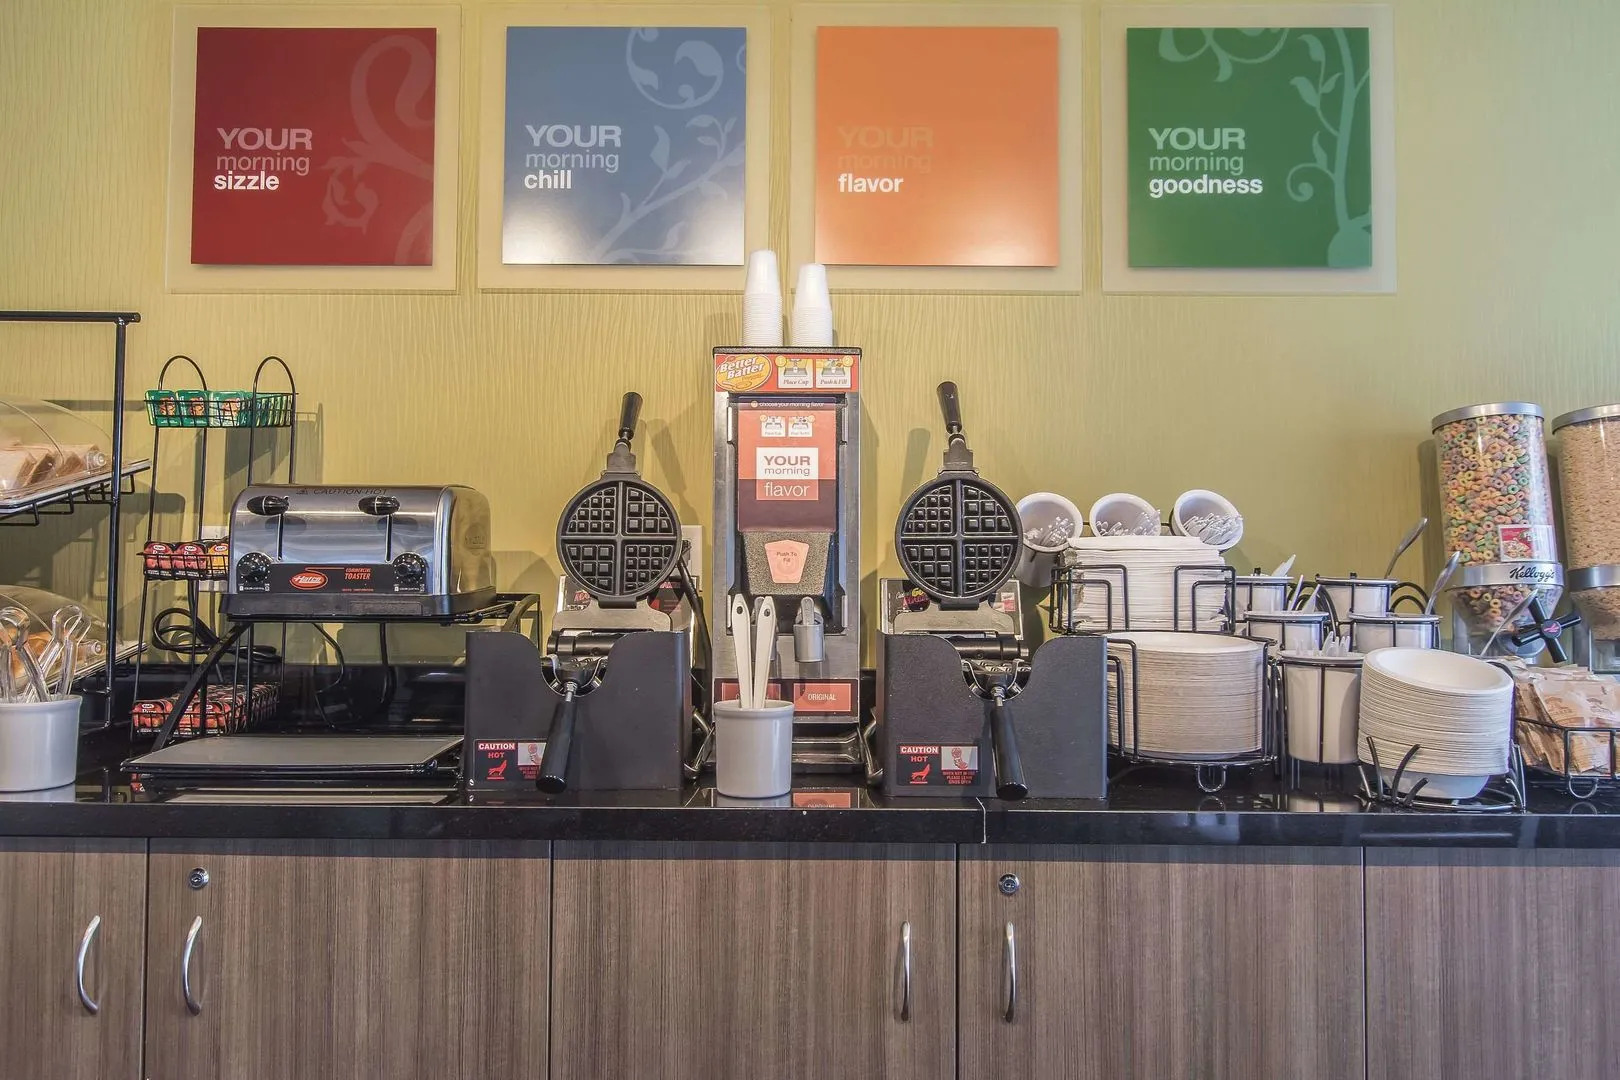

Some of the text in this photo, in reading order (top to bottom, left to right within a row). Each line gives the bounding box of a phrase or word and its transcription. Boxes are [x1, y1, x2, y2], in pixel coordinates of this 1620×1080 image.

[216, 127, 313, 151] YOUR
[524, 124, 622, 148] YOUR
[837, 125, 934, 149] YOUR
[1148, 127, 1247, 151] YOUR
[216, 153, 311, 177] morning
[524, 149, 620, 174] morning
[838, 153, 932, 175] morning
[1149, 153, 1244, 177] morning
[213, 171, 280, 191] sizzle
[524, 169, 573, 190] chill
[838, 172, 905, 193] flavor
[1148, 175, 1264, 199] goodness
[719, 356, 758, 373] Better
[764, 455, 811, 466] YOUR
[764, 466, 811, 477] morning
[764, 481, 810, 497] flavor
[344, 572, 371, 580] TOASTER
[1509, 565, 1555, 582] Kellogg's
[808, 693, 837, 701] ORIGINAL
[478, 742, 516, 750] CAUTION
[901, 746, 939, 754] CAUTION
